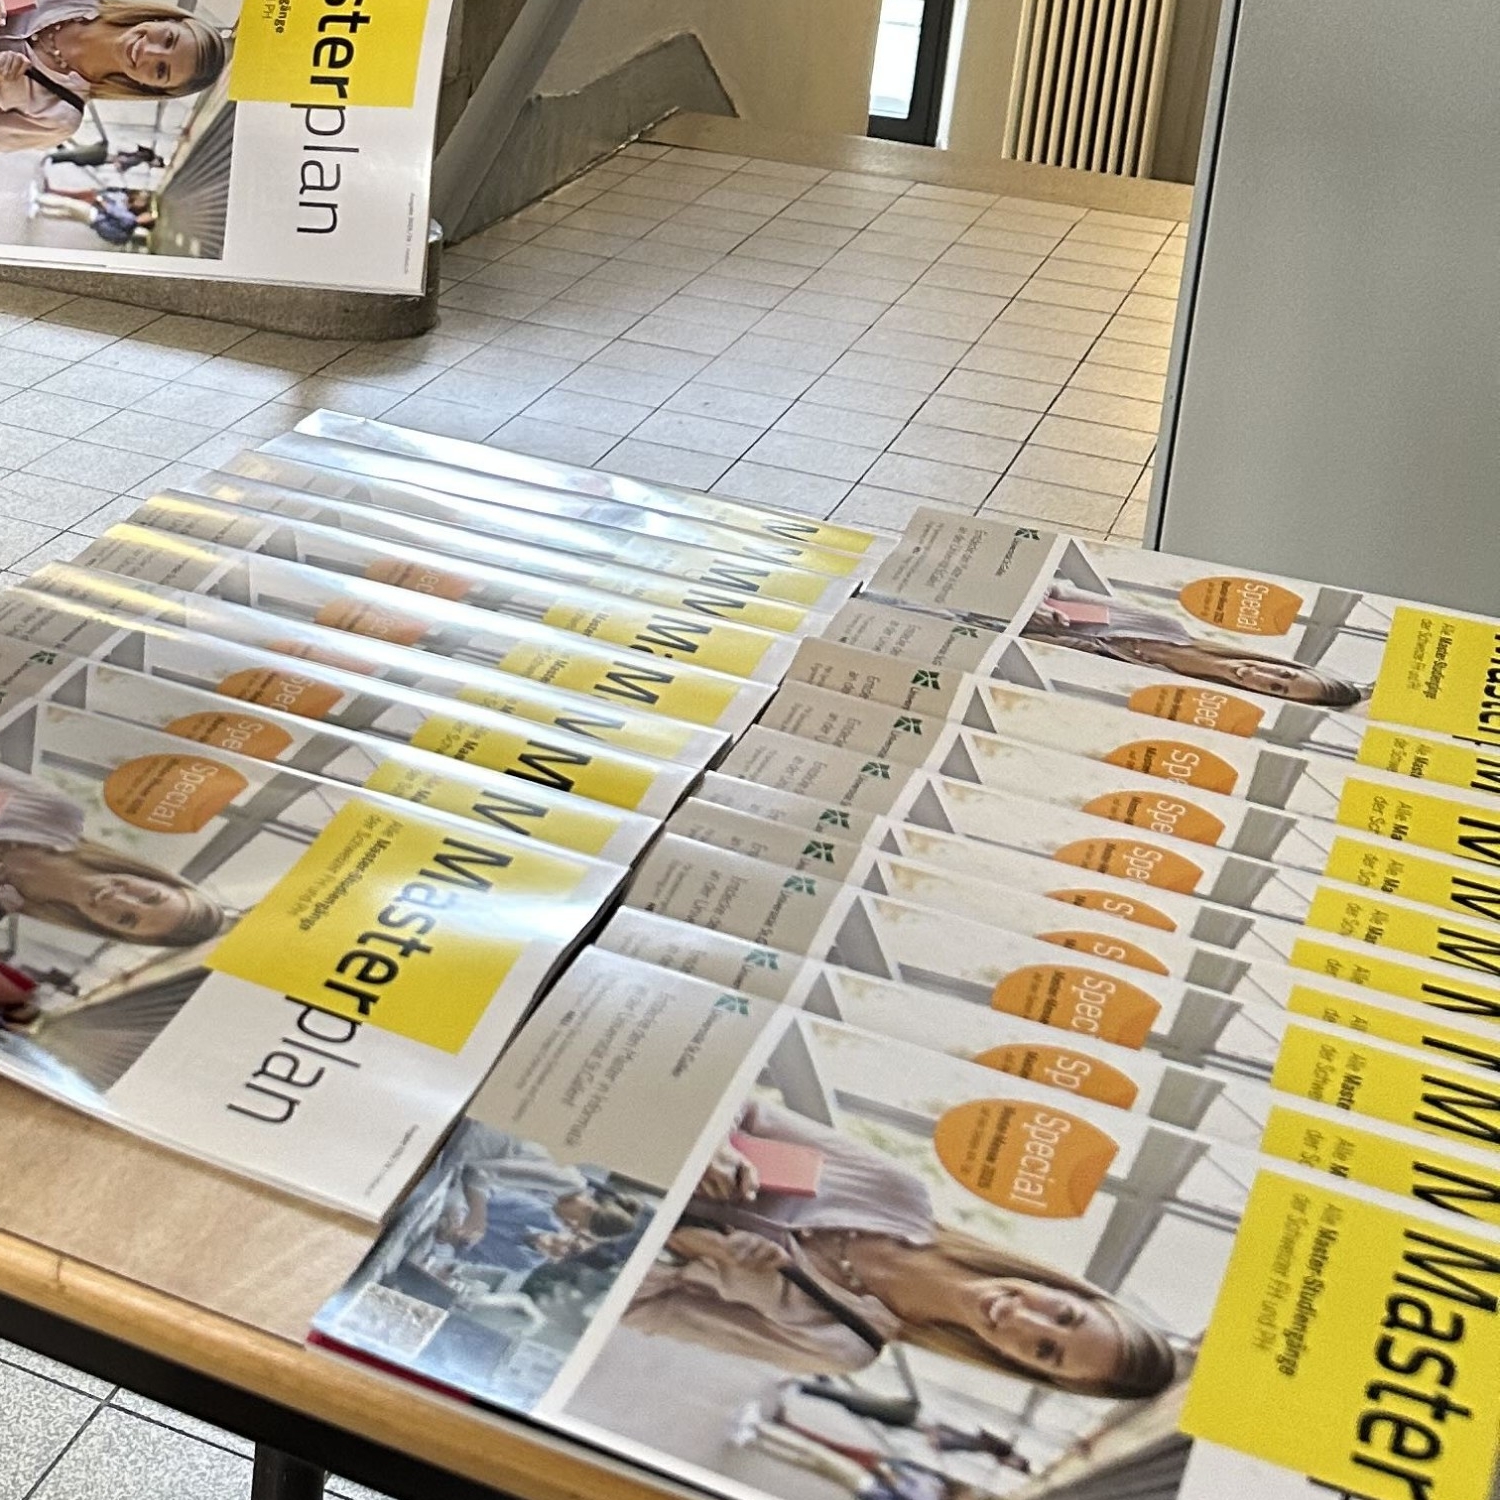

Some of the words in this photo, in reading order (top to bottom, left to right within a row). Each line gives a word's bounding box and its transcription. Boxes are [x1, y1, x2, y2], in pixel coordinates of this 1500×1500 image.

[1235, 582, 1270, 631] Special
[147, 763, 220, 827] Special
[226, 837, 513, 1124] Masterplan
[1009, 1112, 1073, 1209] Special
[1276, 1227, 1340, 1377] Master-Studiengänge
[1307, 1229, 1500, 1500] Master
